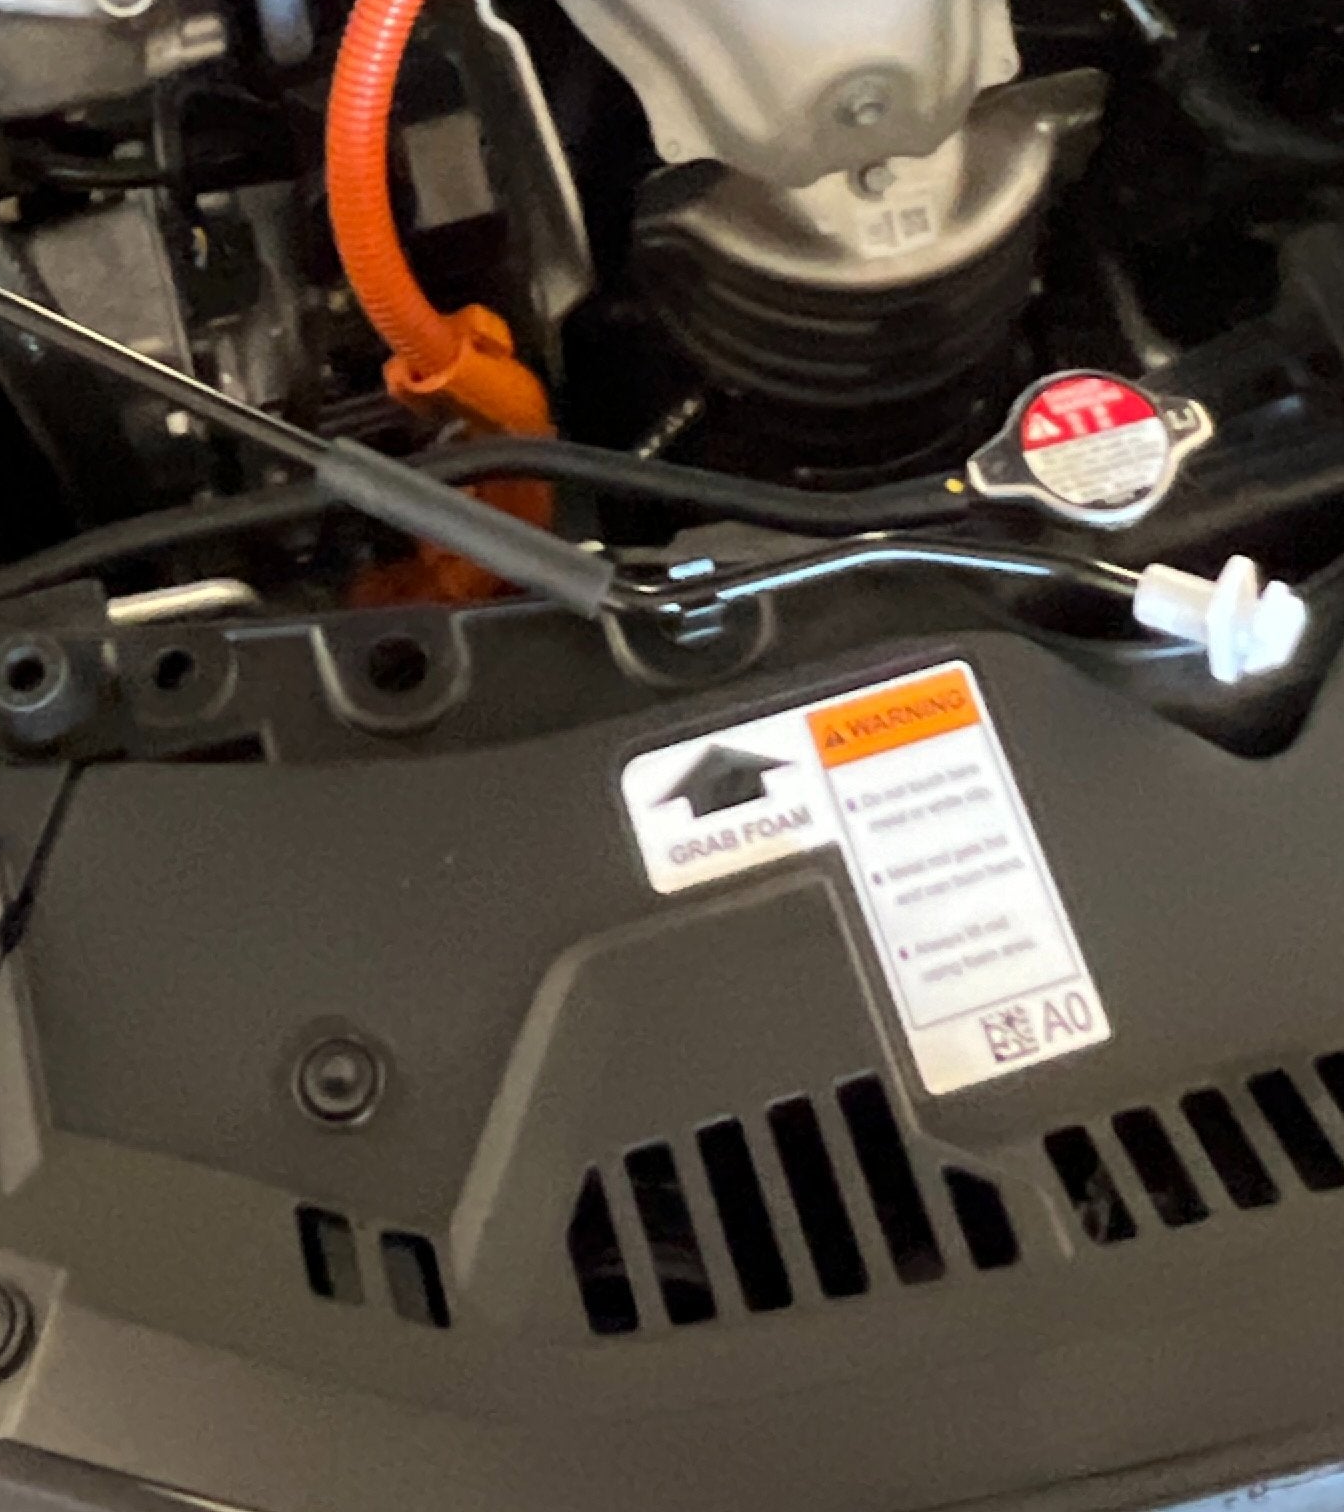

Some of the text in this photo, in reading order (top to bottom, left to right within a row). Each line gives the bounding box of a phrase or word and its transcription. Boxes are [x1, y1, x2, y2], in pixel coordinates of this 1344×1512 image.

[845, 688, 966, 739] WARNING
[669, 806, 813, 865] GRAB FOAM
